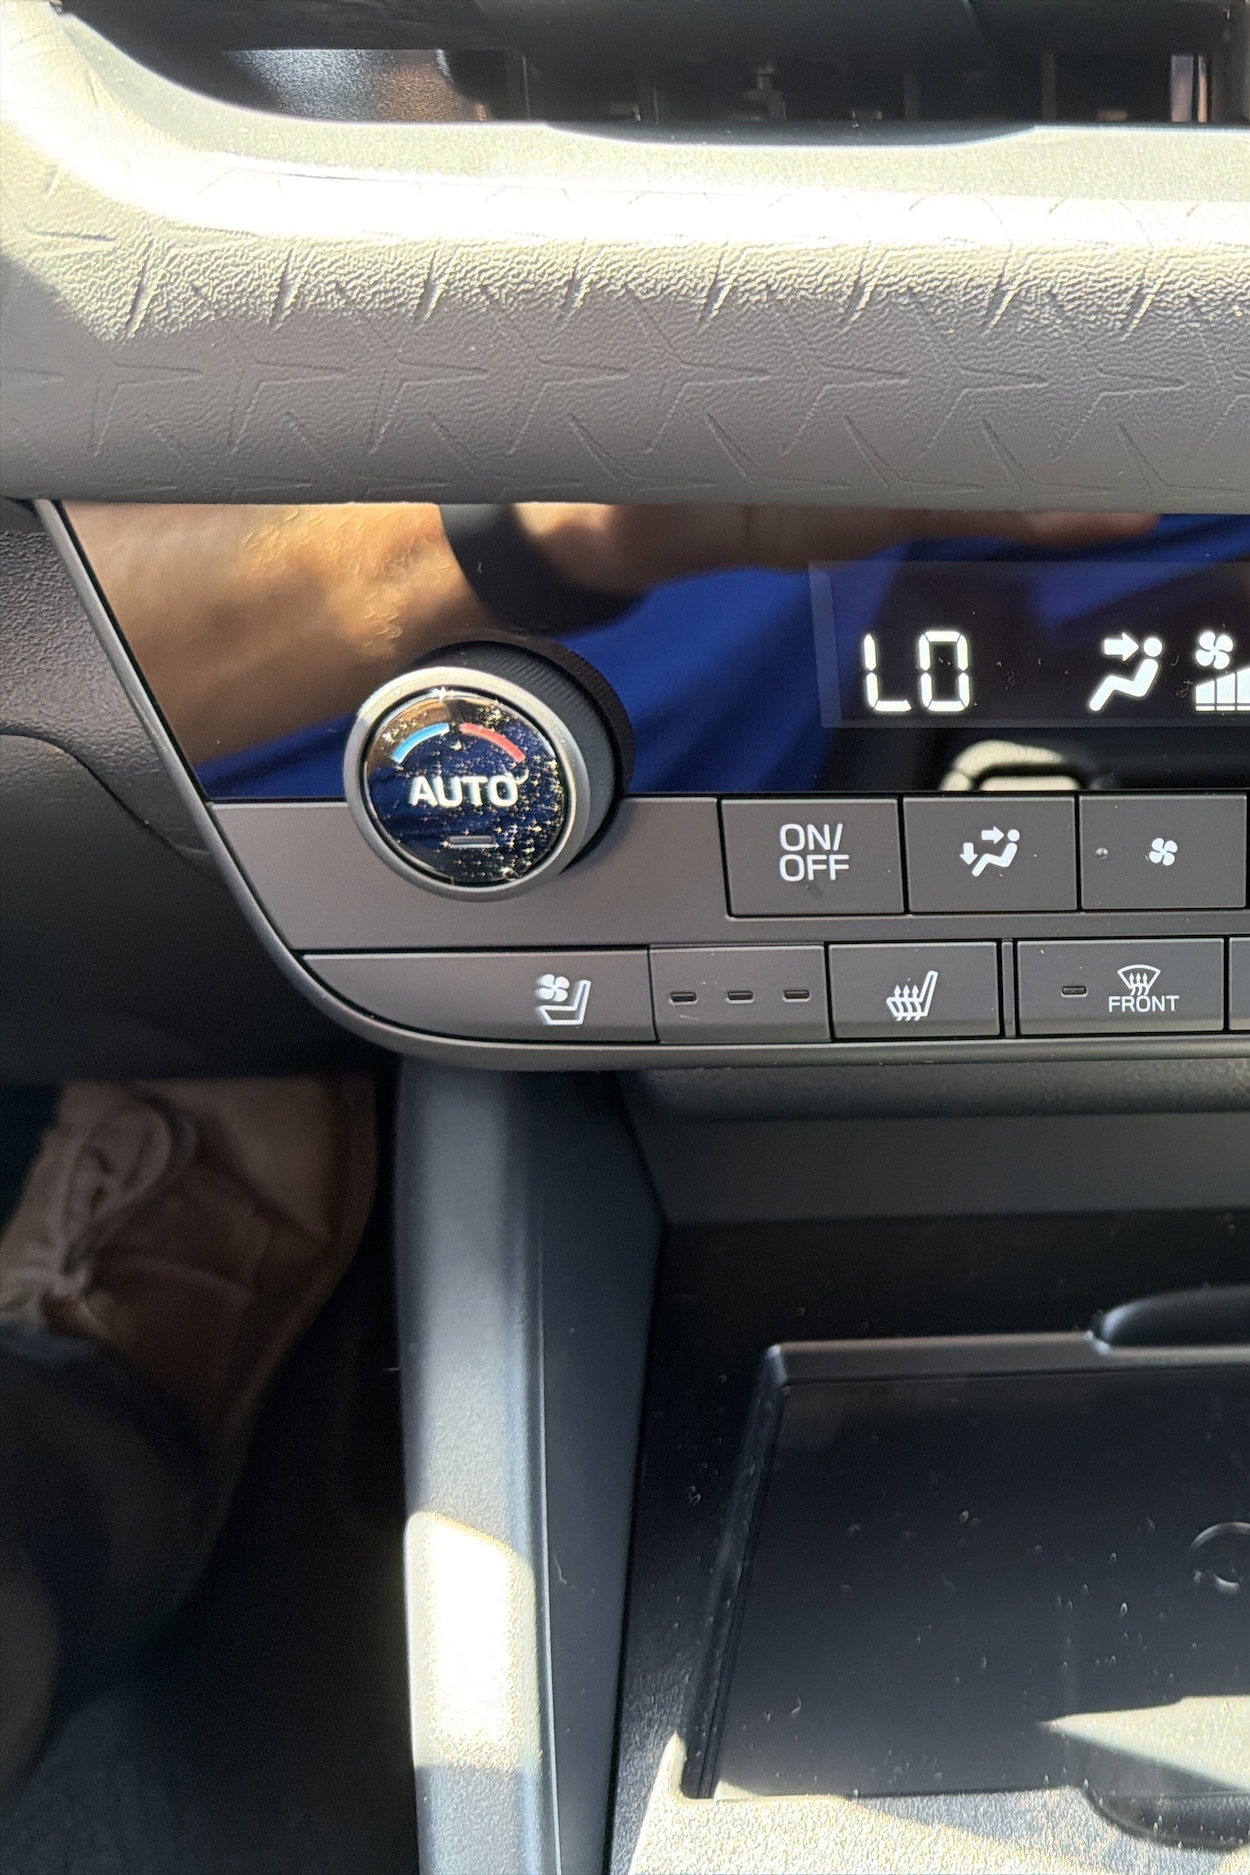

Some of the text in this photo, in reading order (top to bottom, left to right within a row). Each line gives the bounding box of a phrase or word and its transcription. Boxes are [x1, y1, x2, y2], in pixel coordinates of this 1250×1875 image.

[407, 774, 520, 808] AUTO
[779, 822, 844, 852] ON/
[779, 853, 850, 882] OFF
[1108, 994, 1180, 1013] FRONT
